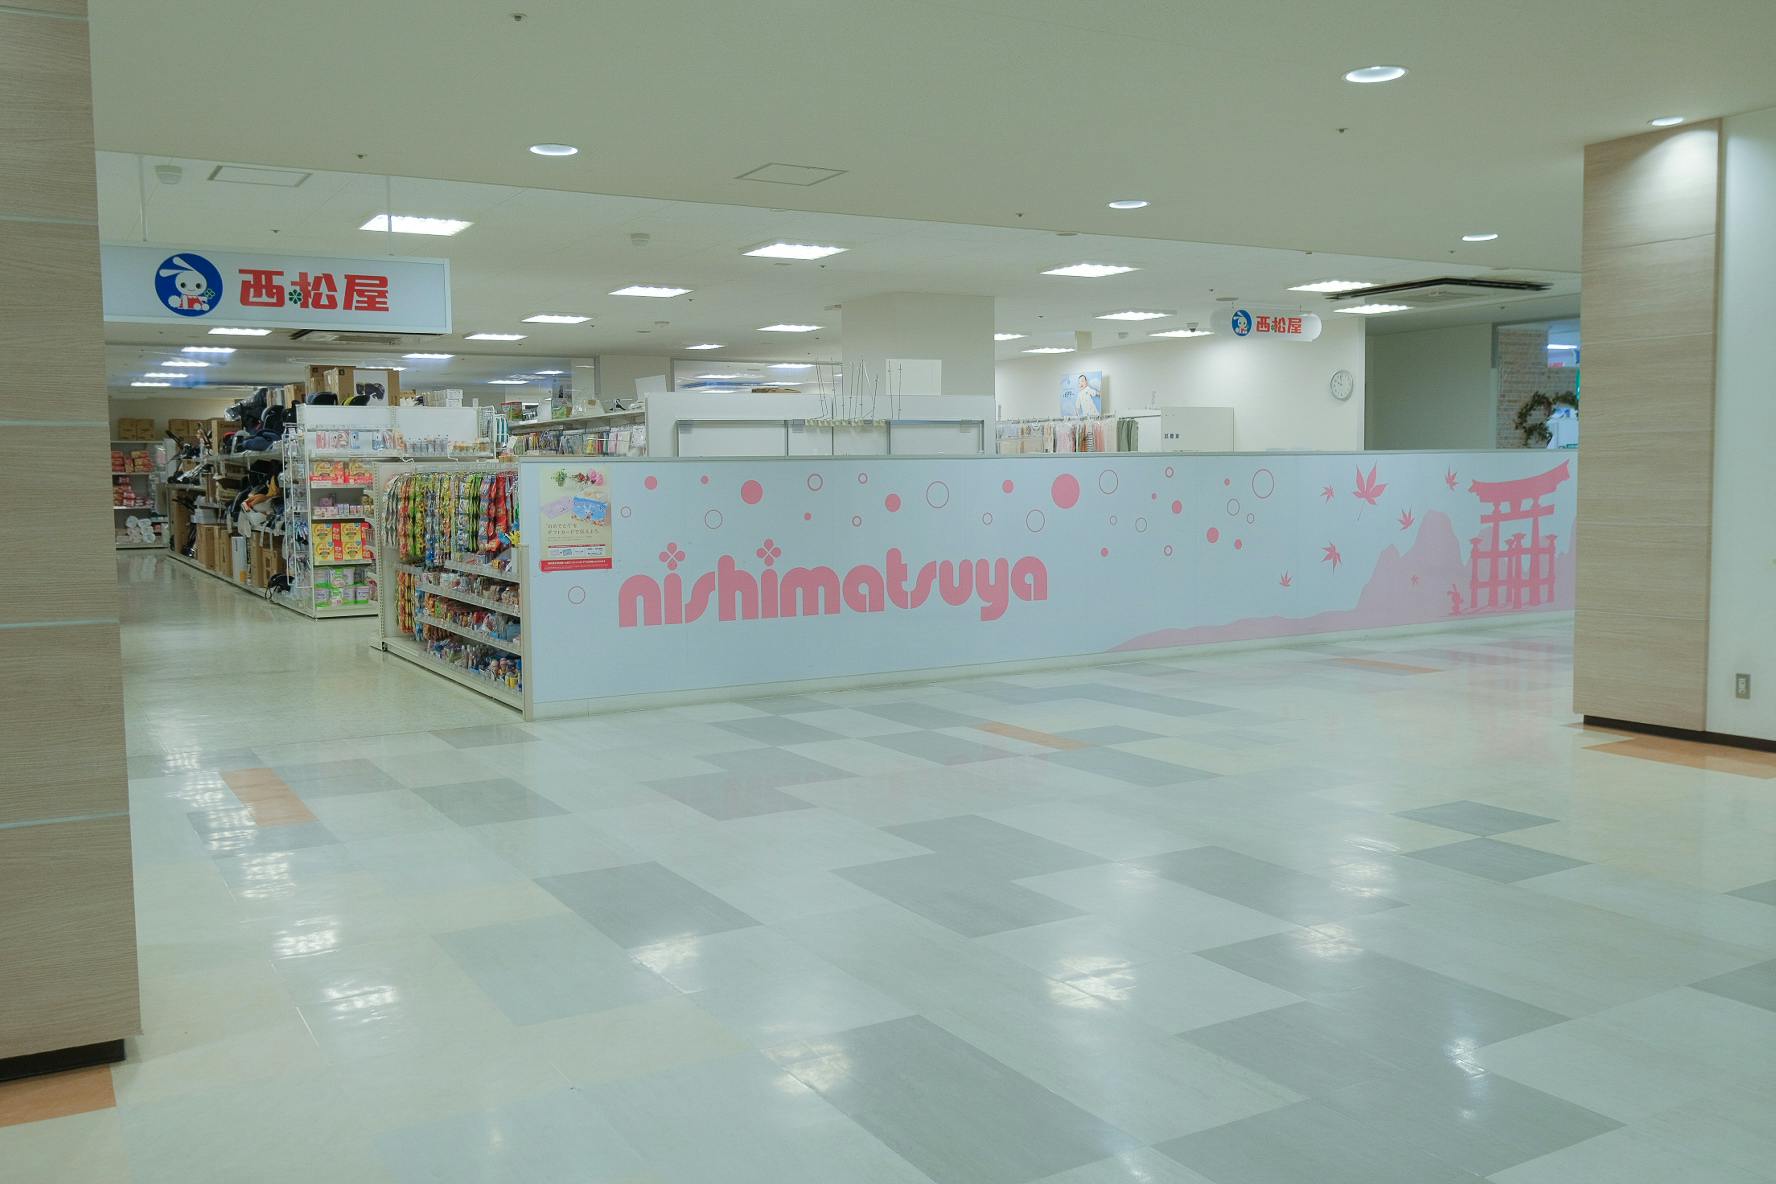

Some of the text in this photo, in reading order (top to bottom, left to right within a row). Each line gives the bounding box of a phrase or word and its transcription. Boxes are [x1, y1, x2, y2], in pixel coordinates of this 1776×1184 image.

[238, 268, 390, 312] 西松屋
[1256, 315, 1302, 334] 西松屋
[618, 538, 1048, 627] nishimatsuya
